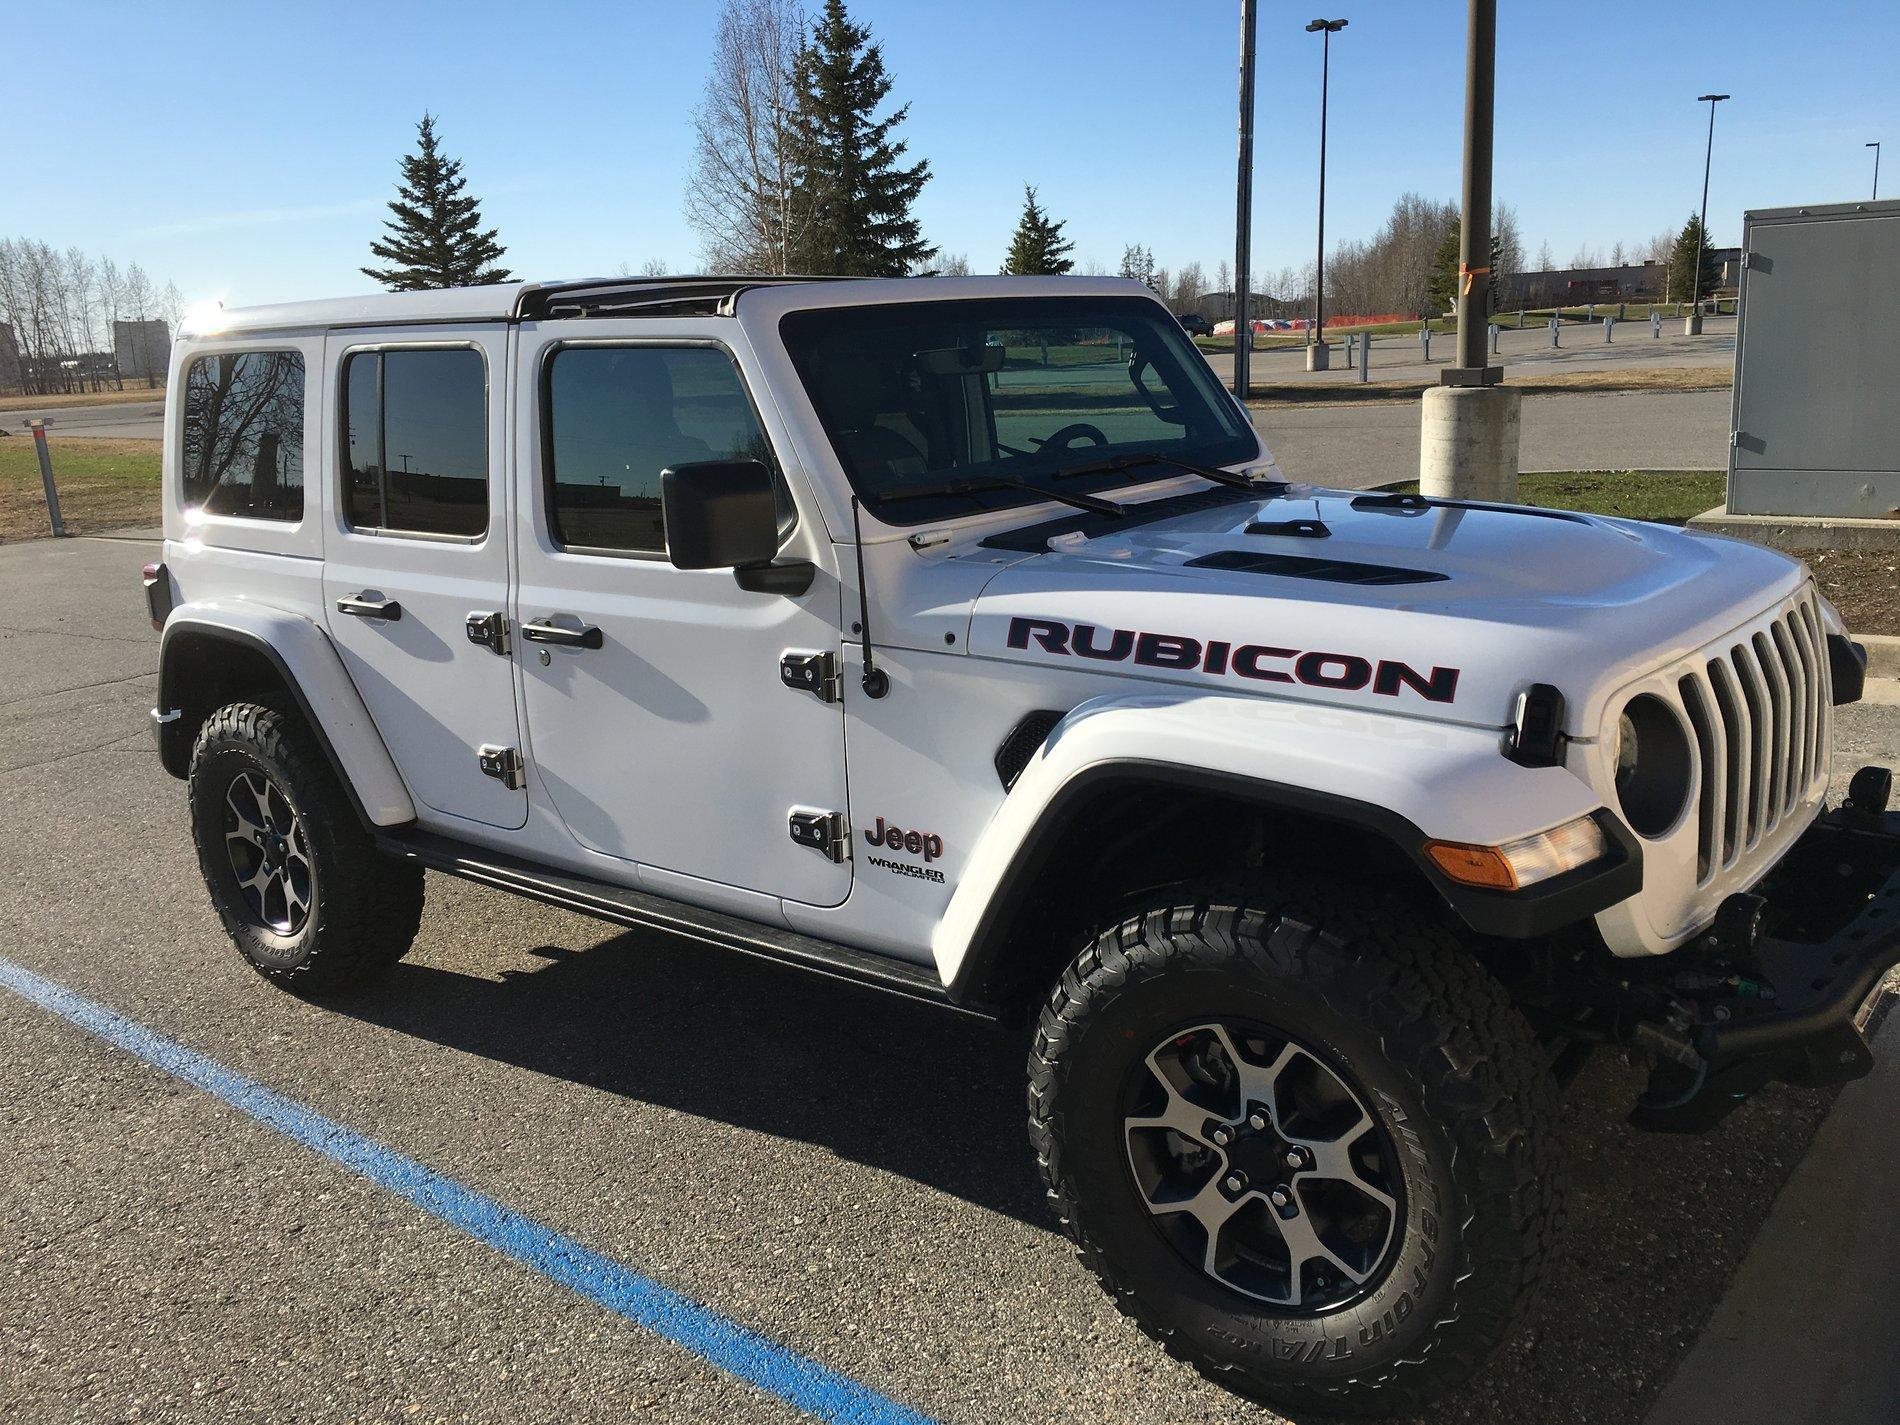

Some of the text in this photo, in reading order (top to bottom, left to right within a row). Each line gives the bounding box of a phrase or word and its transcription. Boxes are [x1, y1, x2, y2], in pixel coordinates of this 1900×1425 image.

[1007, 617, 1461, 704] RUBICON
[865, 816, 944, 863] Jeep
[867, 856, 944, 880] WRANGLER
[891, 869, 946, 884] UNLIMITED
